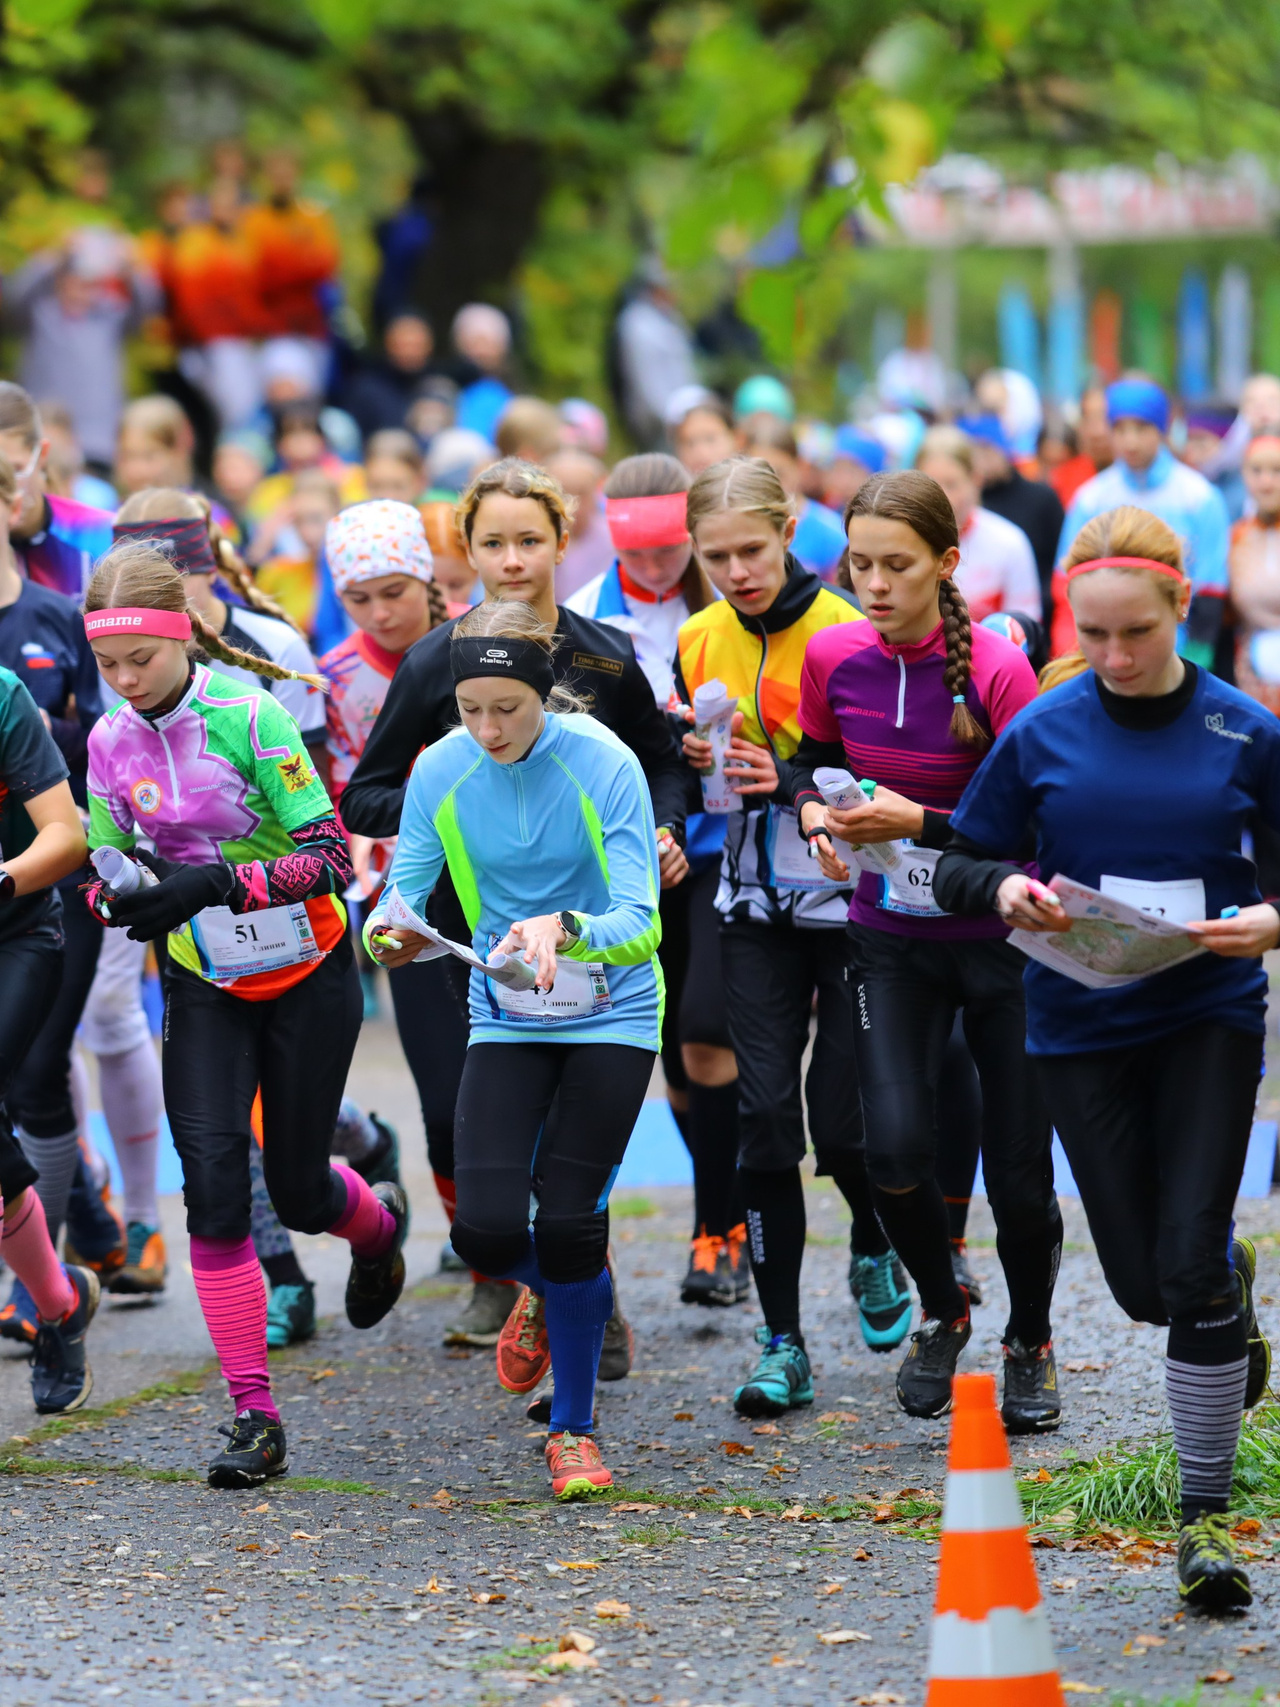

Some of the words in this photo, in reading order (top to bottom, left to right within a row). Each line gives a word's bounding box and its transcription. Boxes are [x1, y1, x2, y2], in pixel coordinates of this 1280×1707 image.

[86, 616, 143, 631] noname
[479, 656, 513, 667] Kalenji
[845, 705, 886, 719] noname
[706, 799, 730, 807] 63.2
[908, 868, 932, 887] 62
[234, 923, 260, 943] 51
[251, 945, 257, 953] 3
[259, 942, 286, 951] линия
[541, 999, 547, 1007] 3
